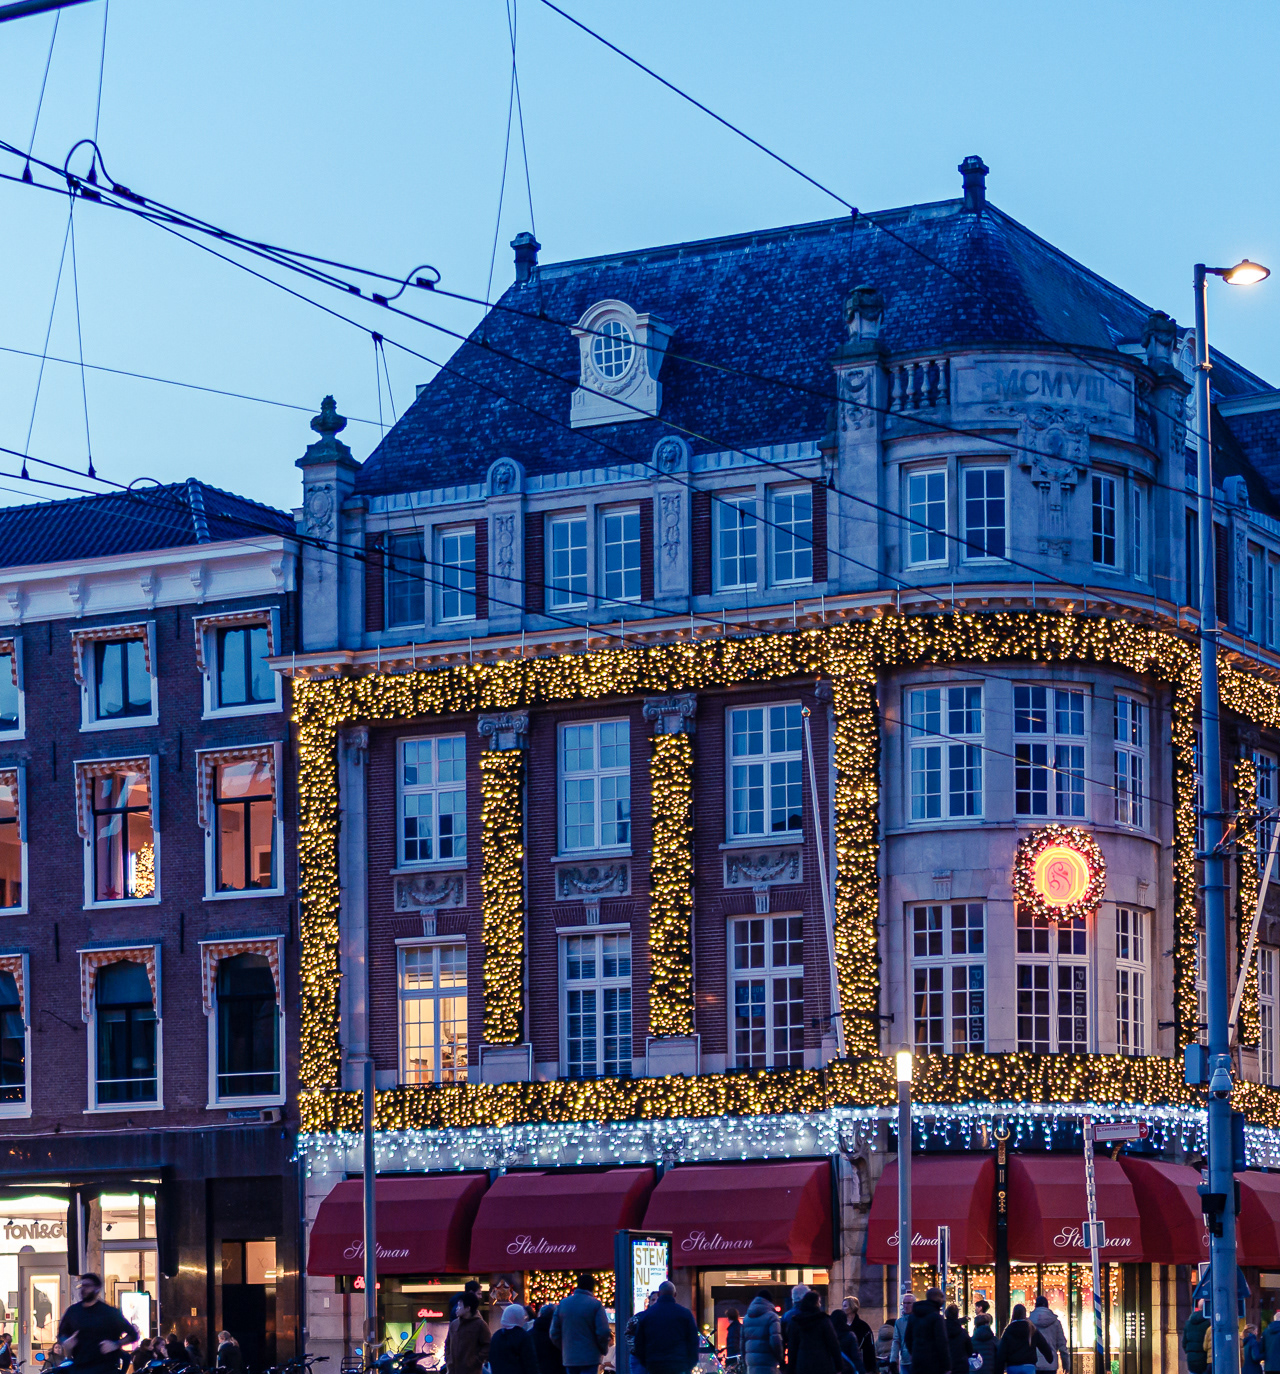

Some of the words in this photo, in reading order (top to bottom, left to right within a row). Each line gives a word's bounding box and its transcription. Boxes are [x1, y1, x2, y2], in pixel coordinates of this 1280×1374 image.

[970, 969, 982, 1041] Palladio
[1075, 970, 1085, 1042] Palladio
[506, 1234, 577, 1255] Steltman
[680, 1230, 754, 1252] Steltman
[635, 1247, 665, 1266] STEM
[636, 1267, 650, 1286] NU
